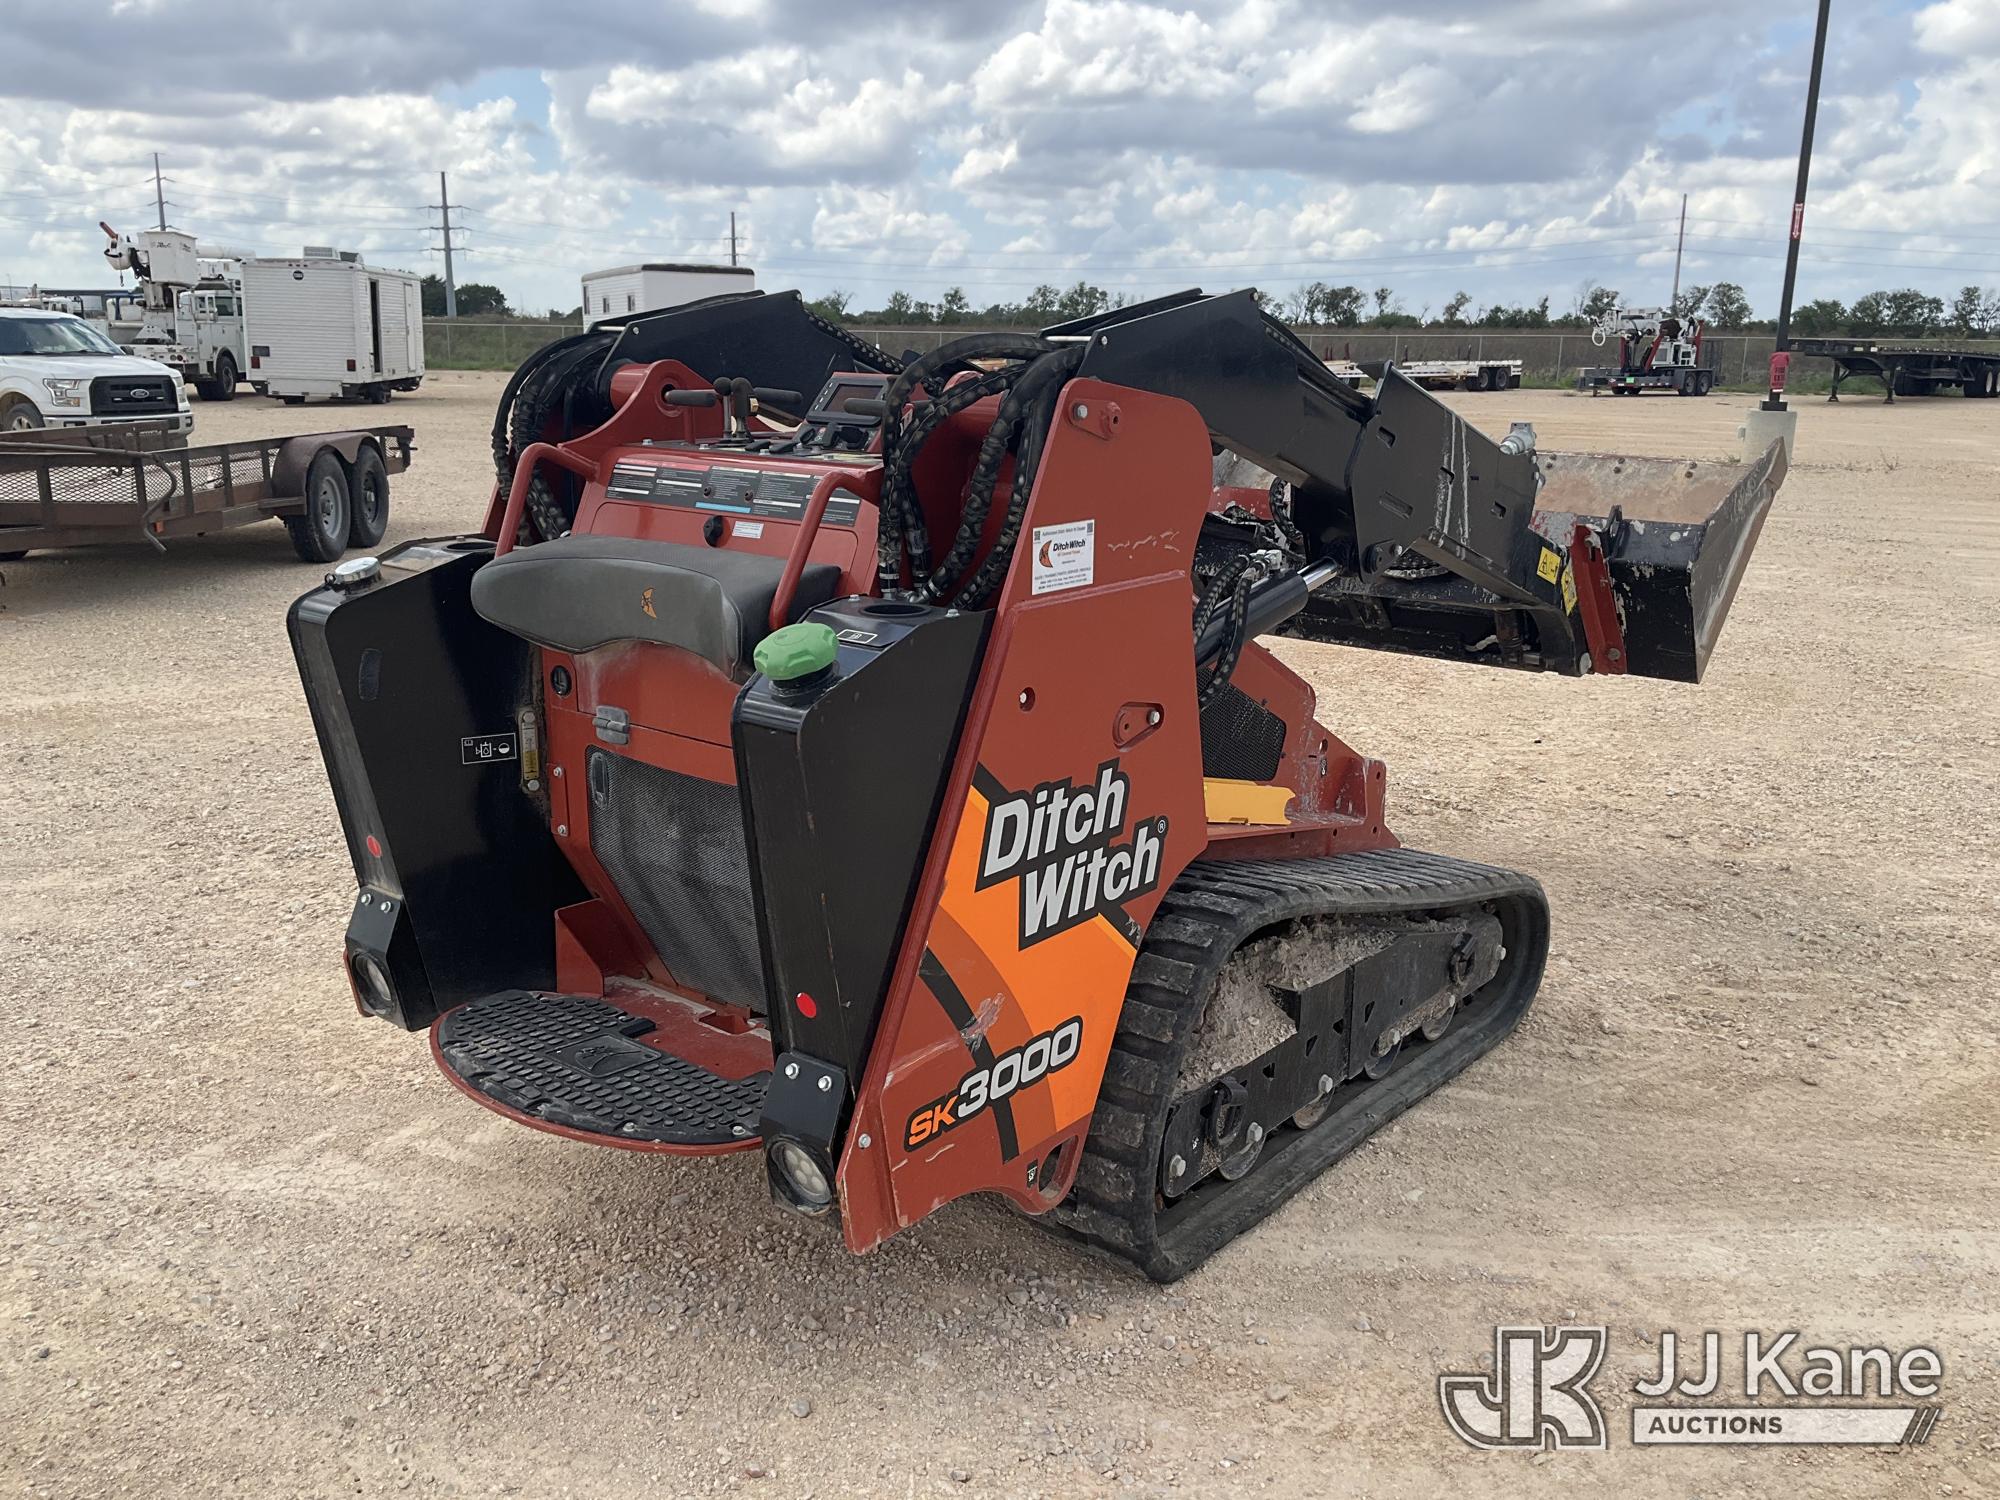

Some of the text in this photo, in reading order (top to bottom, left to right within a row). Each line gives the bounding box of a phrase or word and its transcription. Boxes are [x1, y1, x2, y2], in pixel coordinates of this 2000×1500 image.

[1053, 539, 1086, 551] Ditch Witch
[984, 768, 1125, 877] Ditch
[908, 1021, 1080, 1145] SK3000
